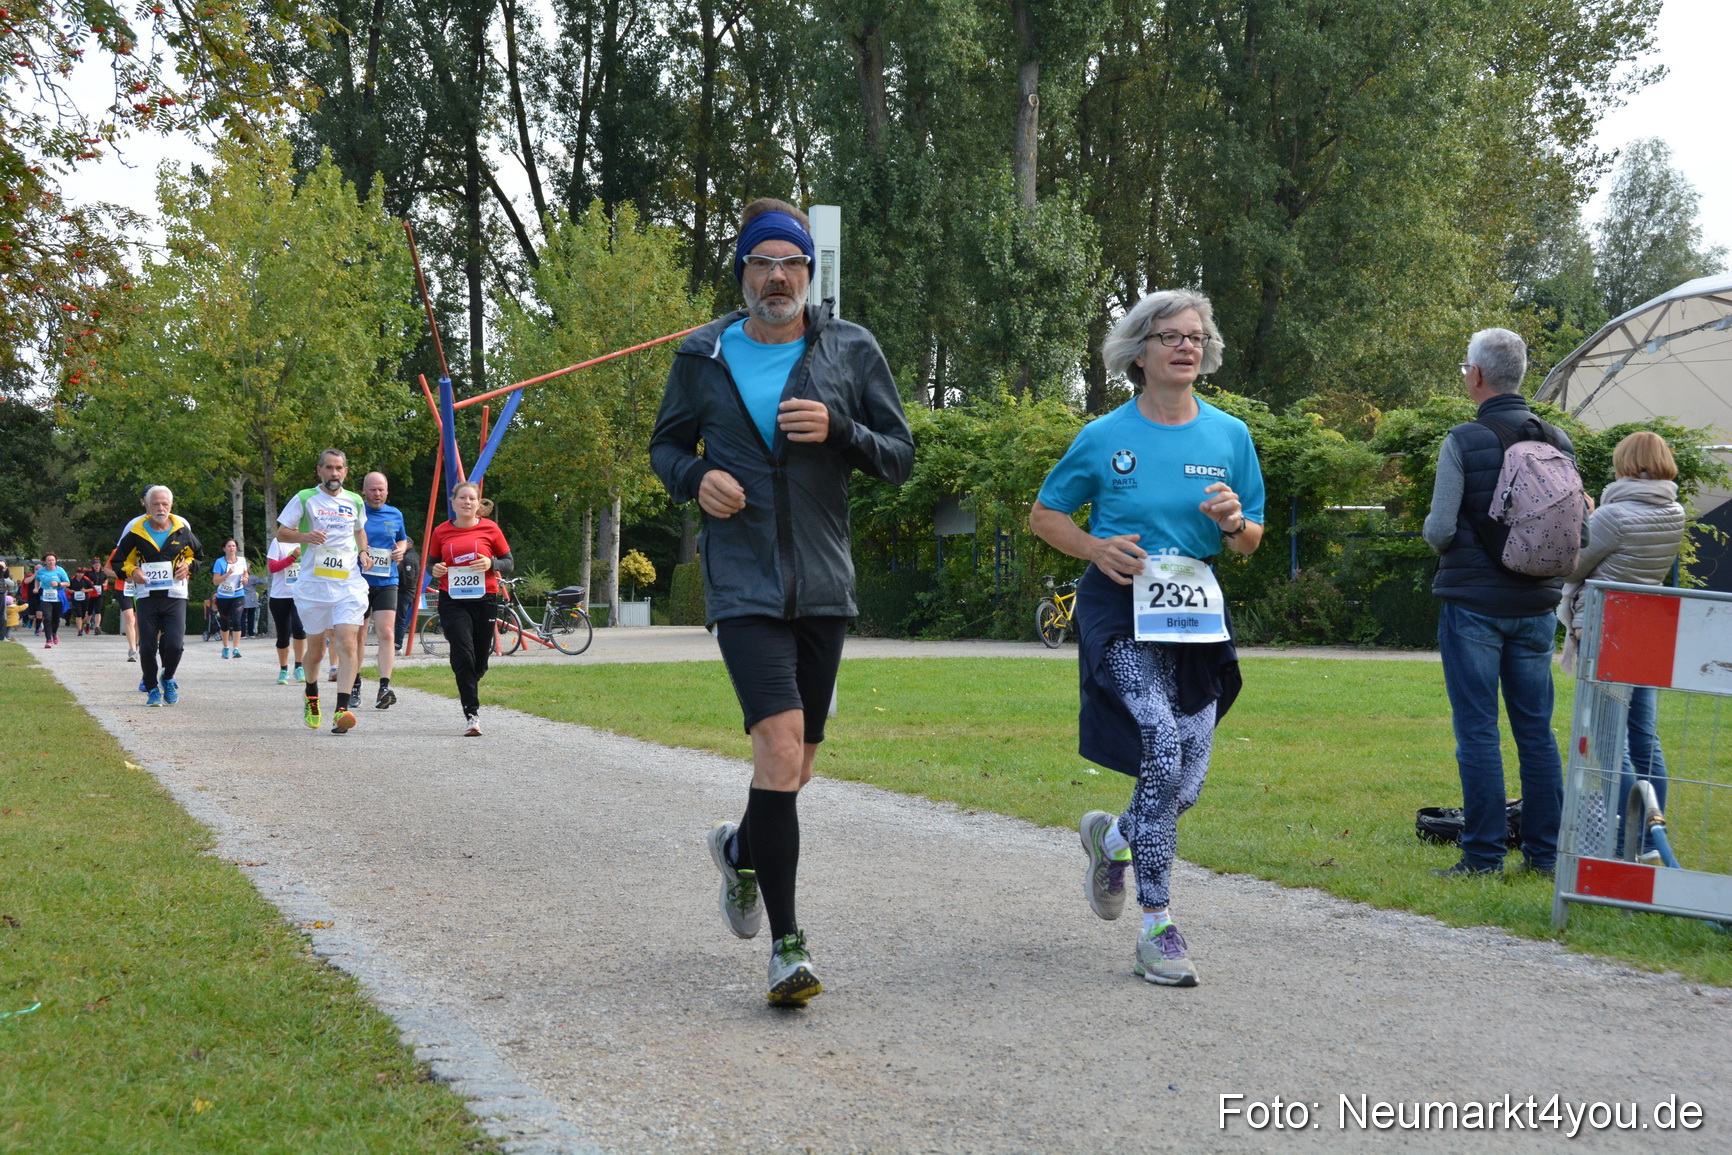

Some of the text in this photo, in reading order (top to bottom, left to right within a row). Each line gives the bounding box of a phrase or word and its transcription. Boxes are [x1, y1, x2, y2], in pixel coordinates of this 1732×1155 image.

[1184, 464, 1227, 478] BOCK
[323, 556, 343, 569] 404
[146, 569, 168, 580] 2212
[453, 575, 480, 586] 2328
[1148, 582, 1208, 608] 2321
[1166, 617, 1199, 629] Brigitte
